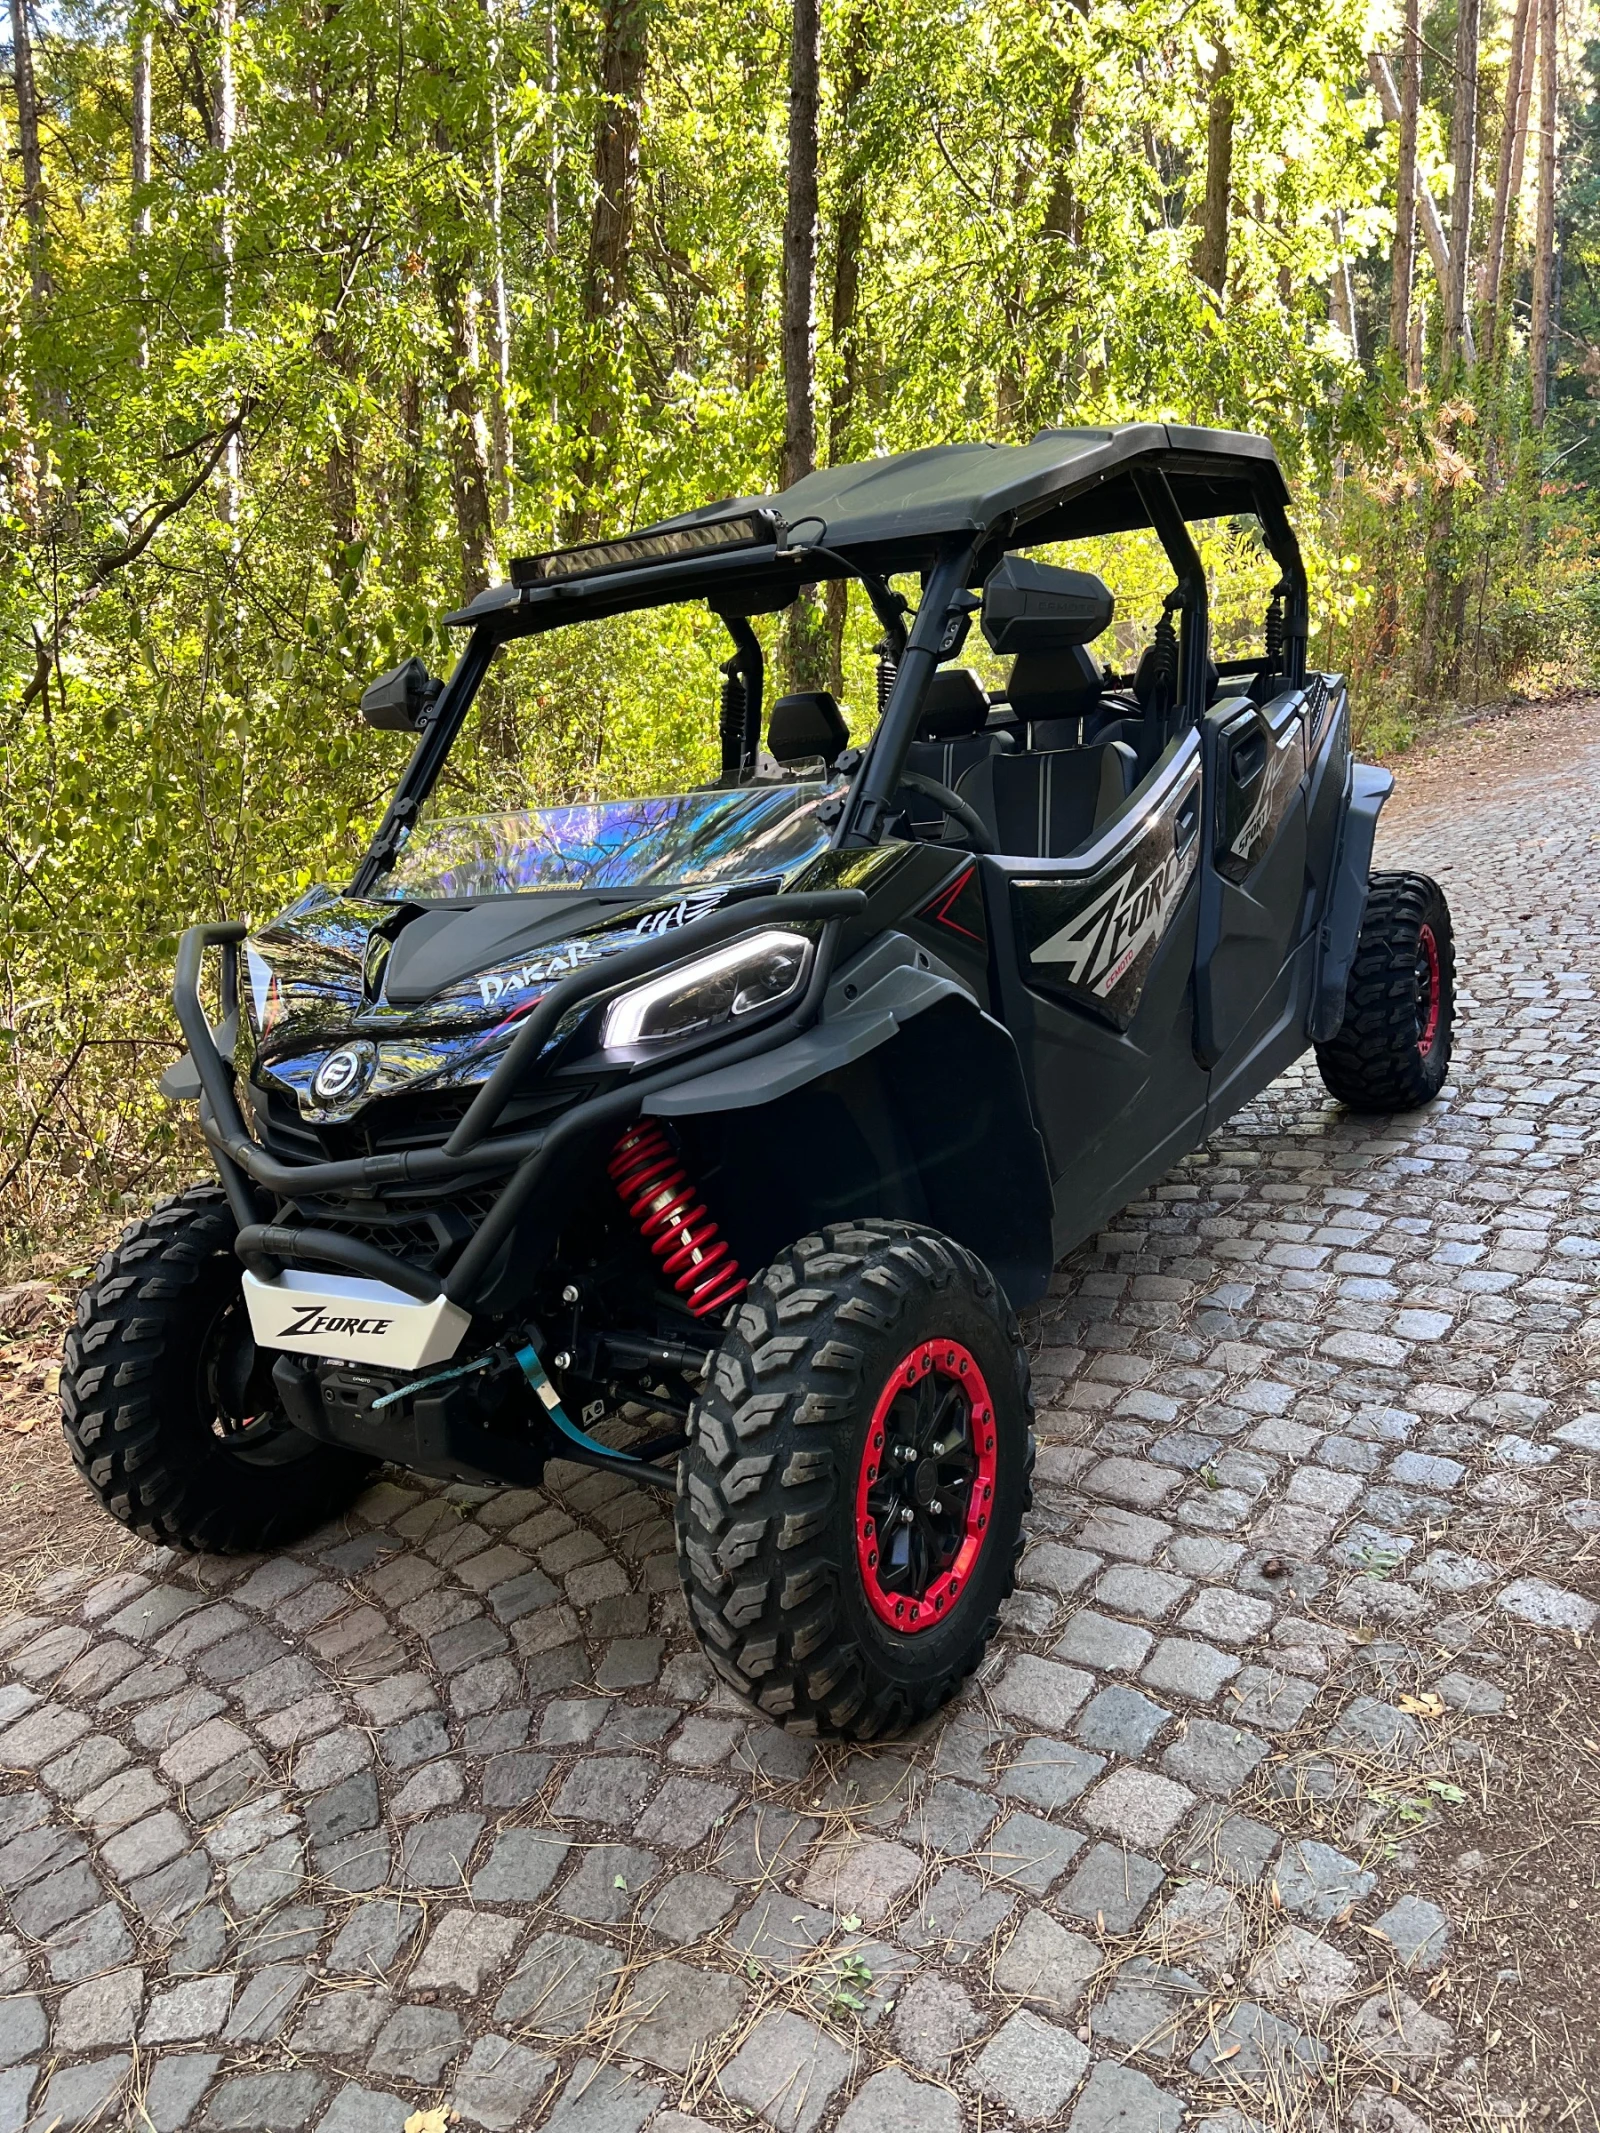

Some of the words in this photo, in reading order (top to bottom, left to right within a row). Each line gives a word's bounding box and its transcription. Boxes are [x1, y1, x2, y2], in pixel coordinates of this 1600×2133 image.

[1238, 808, 1267, 854] SPORT
[477, 941, 602, 1006] DAKAR
[1105, 949, 1134, 990] CFMOTO
